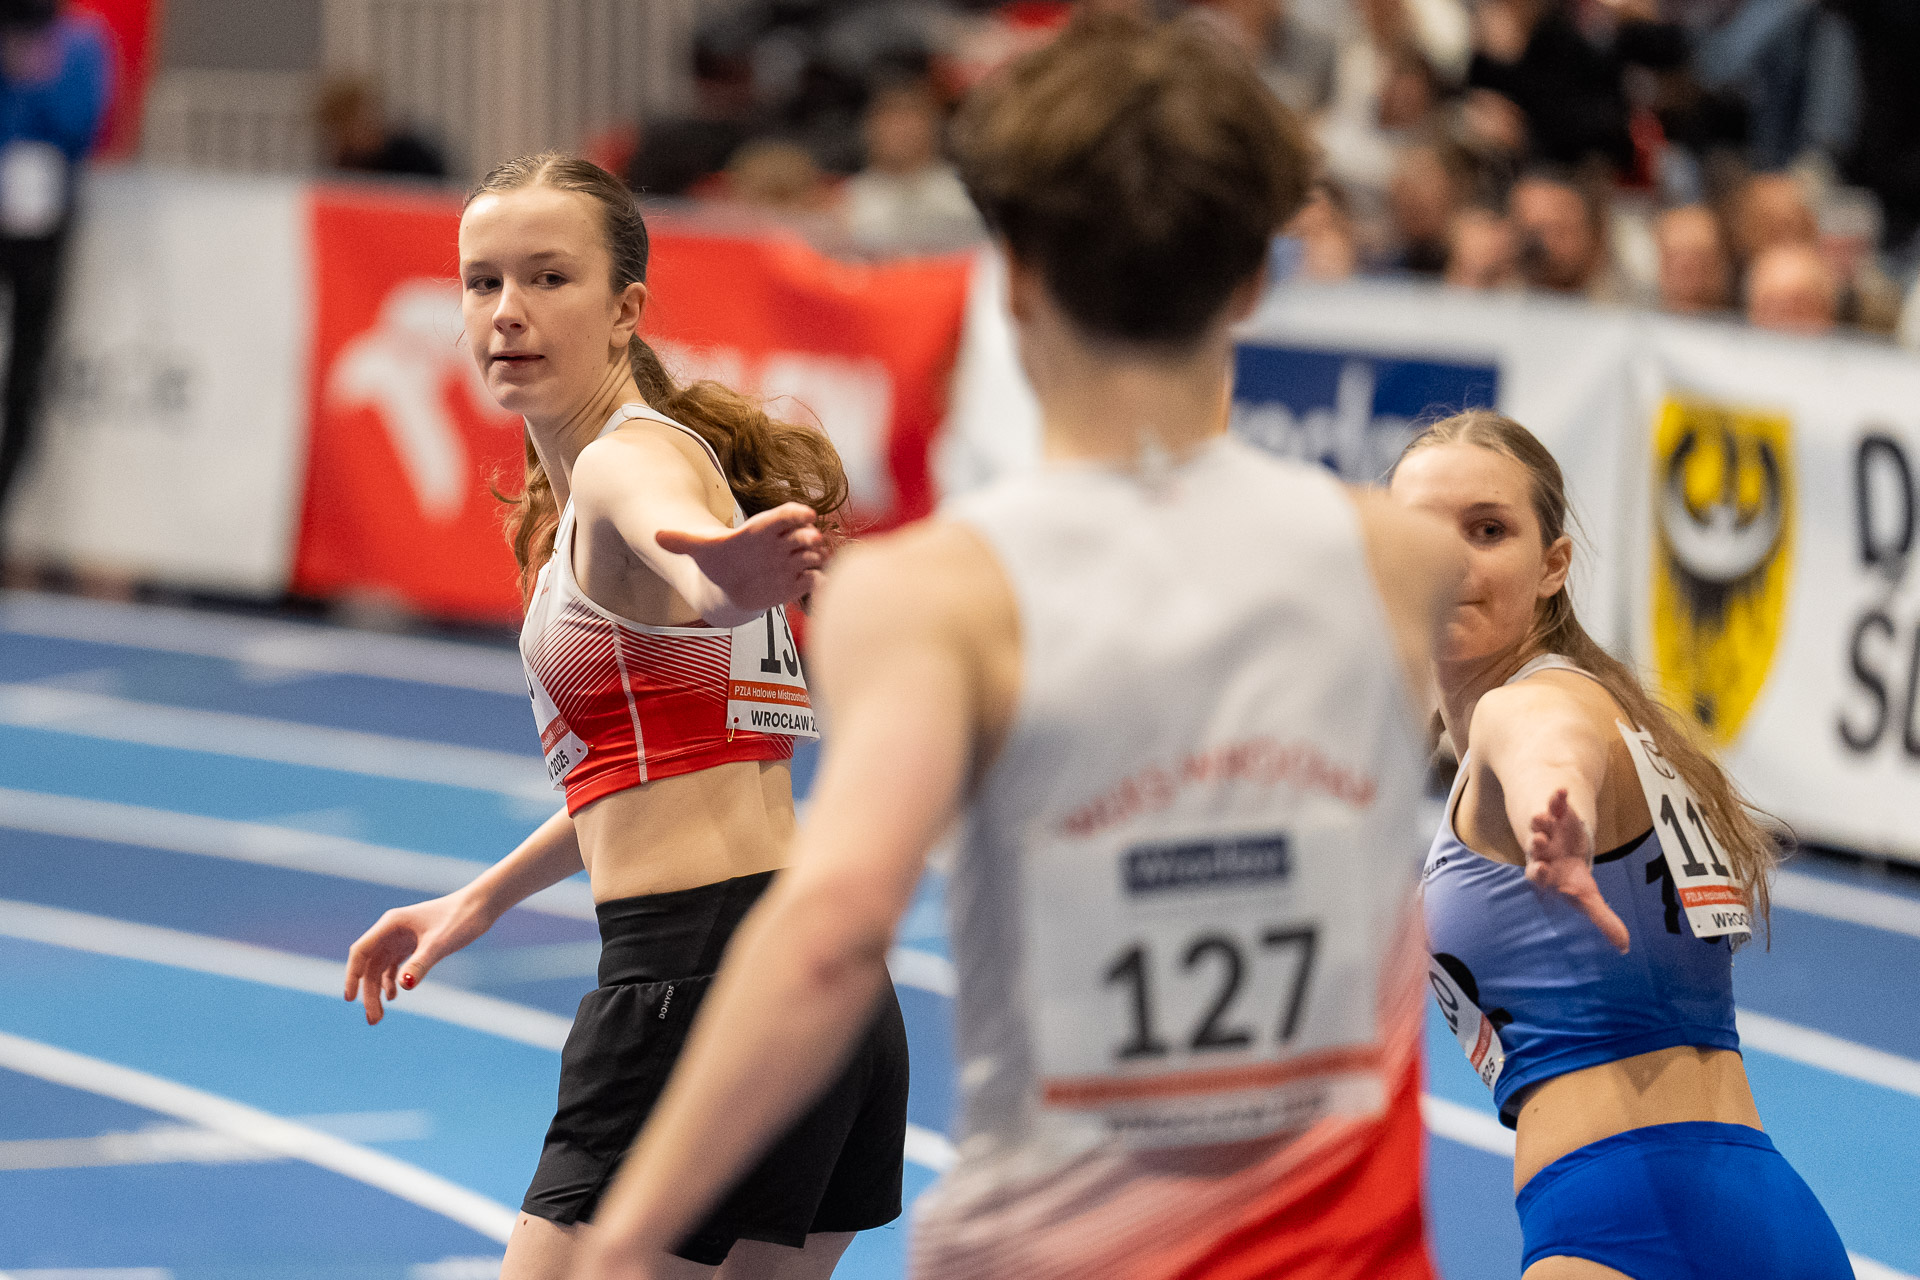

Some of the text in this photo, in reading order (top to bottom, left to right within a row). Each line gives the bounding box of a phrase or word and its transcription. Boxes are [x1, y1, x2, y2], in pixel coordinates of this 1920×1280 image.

[734, 685, 751, 697] PZLA
[752, 687, 776, 699] Halowe
[751, 709, 809, 731] WROCŁAW
[551, 749, 570, 777] 2025
[1660, 794, 1731, 877] 11
[658, 985, 675, 1020] DOMYOS
[1104, 925, 1319, 1061] 127
